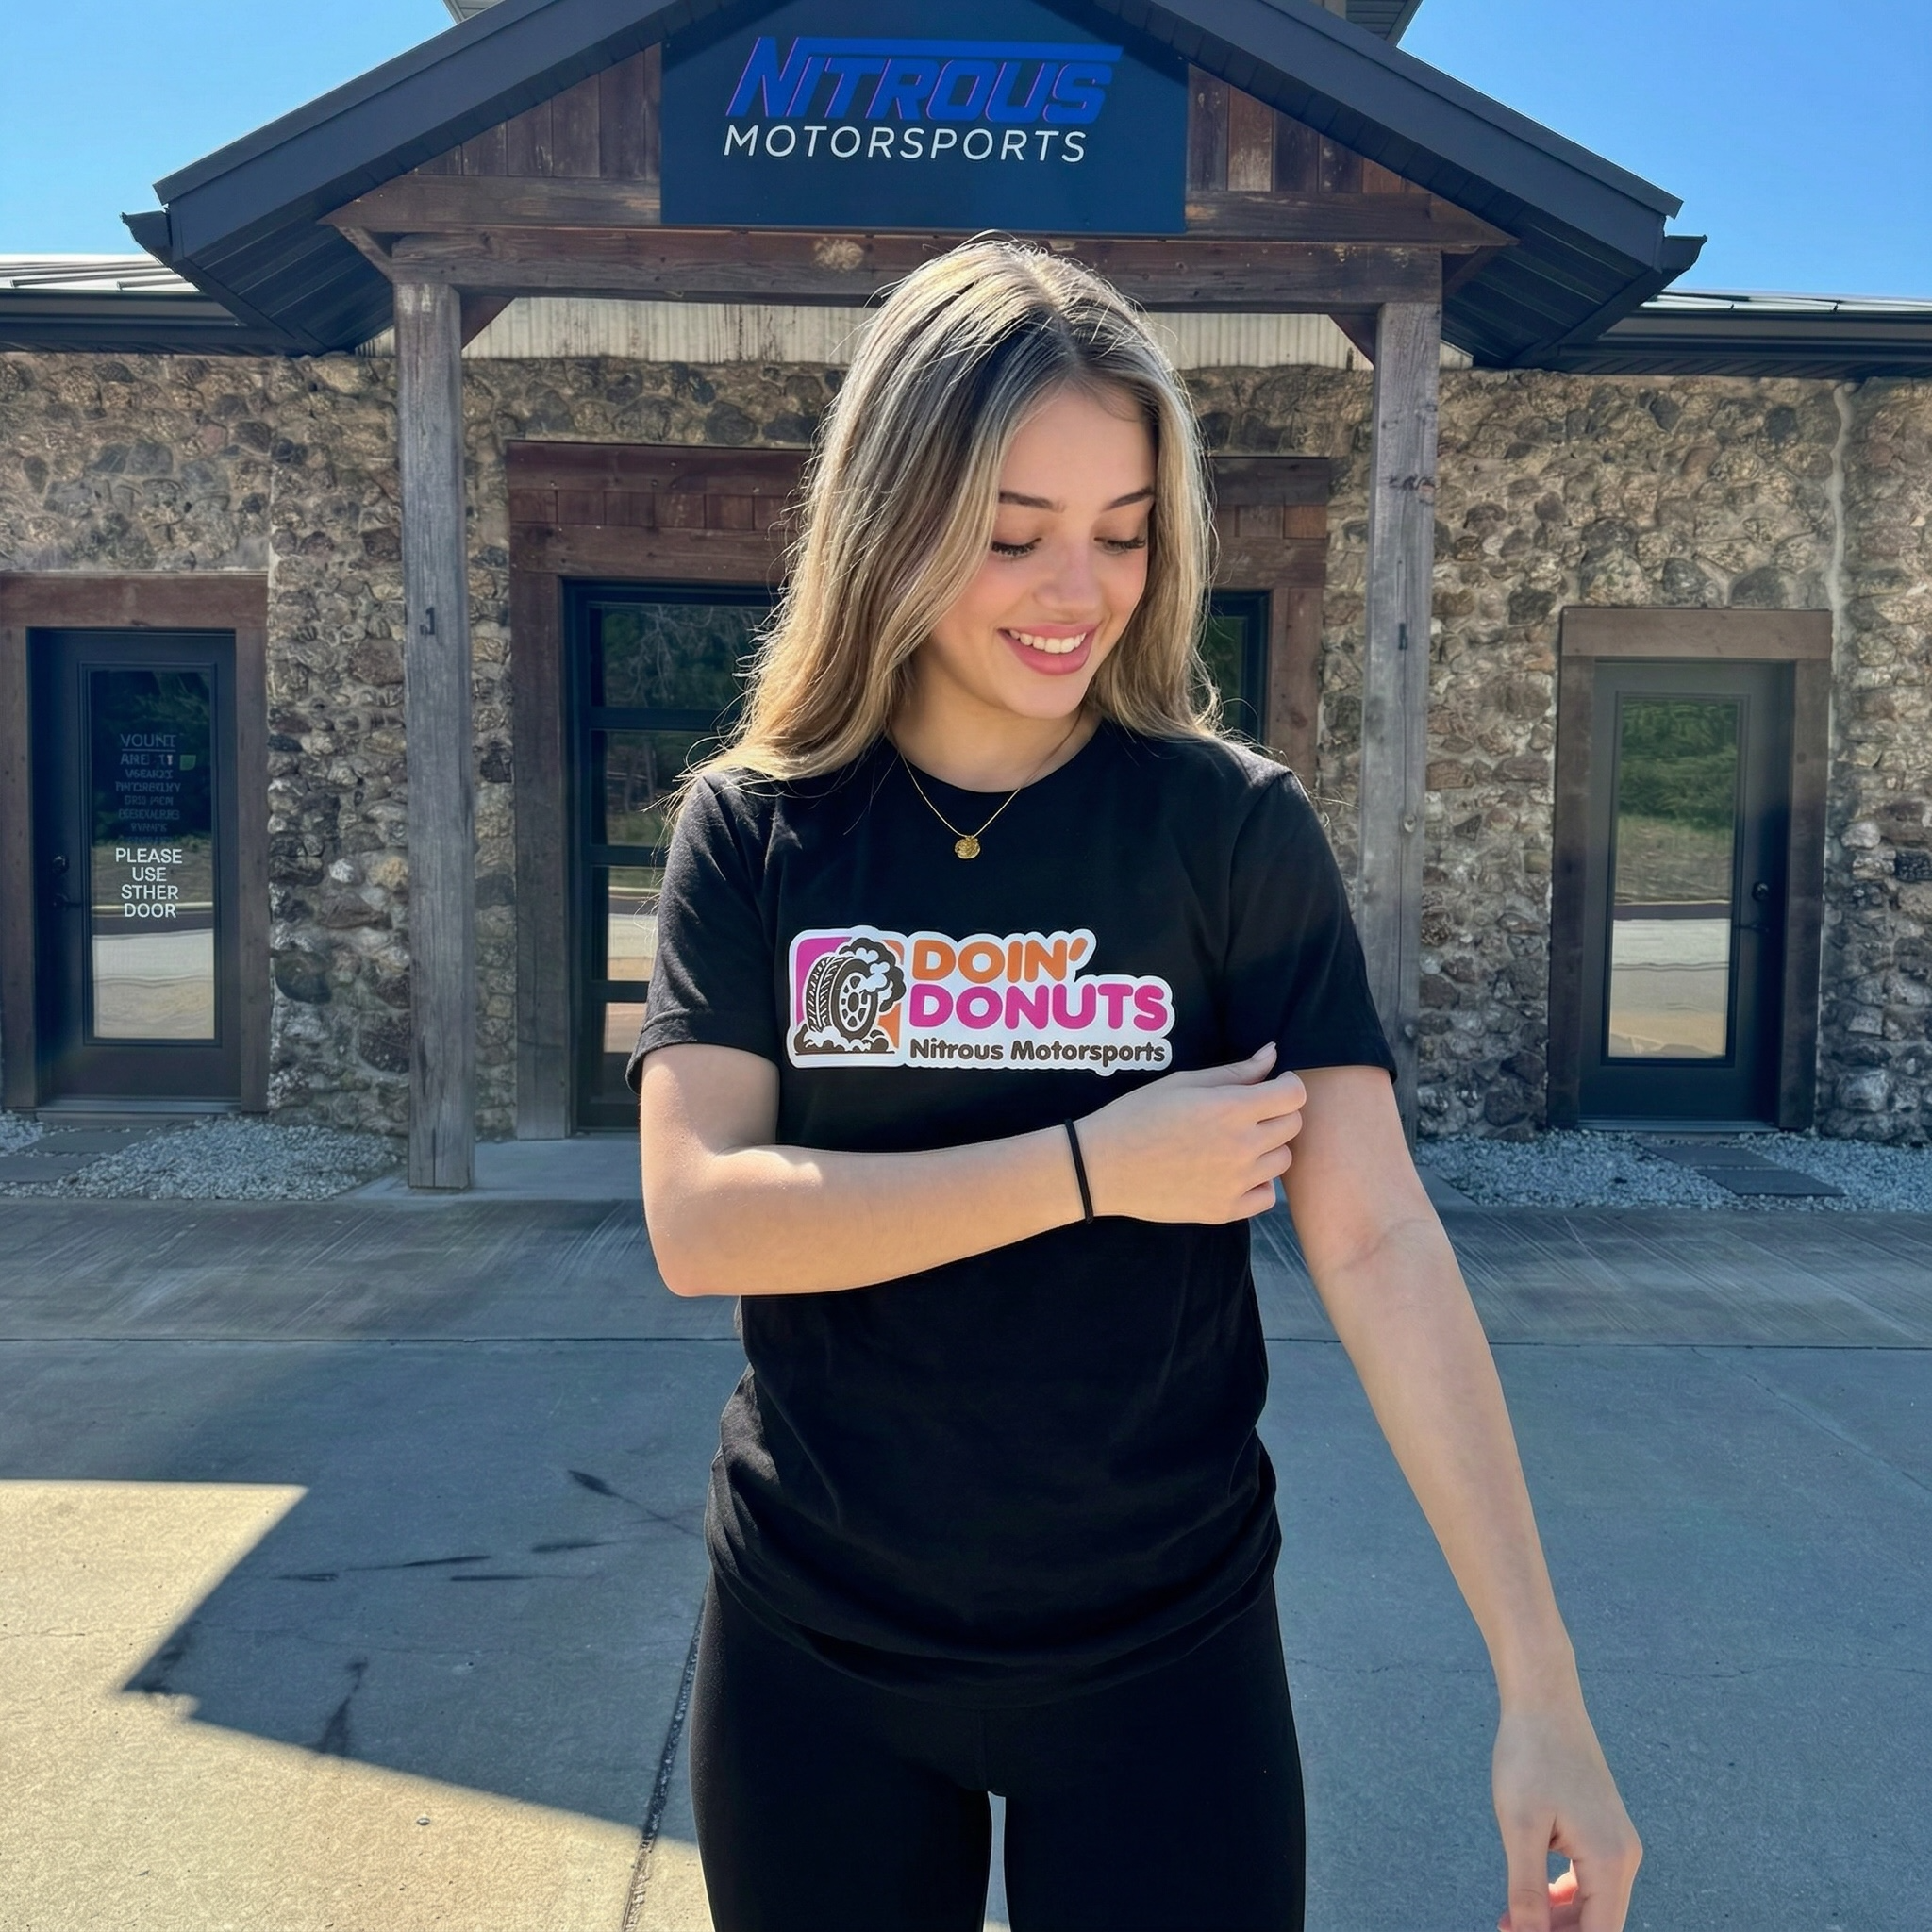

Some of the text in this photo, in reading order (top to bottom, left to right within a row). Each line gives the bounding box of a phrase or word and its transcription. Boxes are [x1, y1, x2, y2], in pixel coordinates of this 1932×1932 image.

[726, 37, 1123, 124] NITROUS
[724, 125, 1086, 162] MOTORSPORTS
[115, 848, 183, 864] PLEASE
[132, 867, 167, 882] USE
[121, 884, 179, 900] STHER
[124, 903, 176, 918] DOOR
[909, 983, 1168, 1031] DONUTS
[909, 1038, 1165, 1067] Nitrous Motorsports
